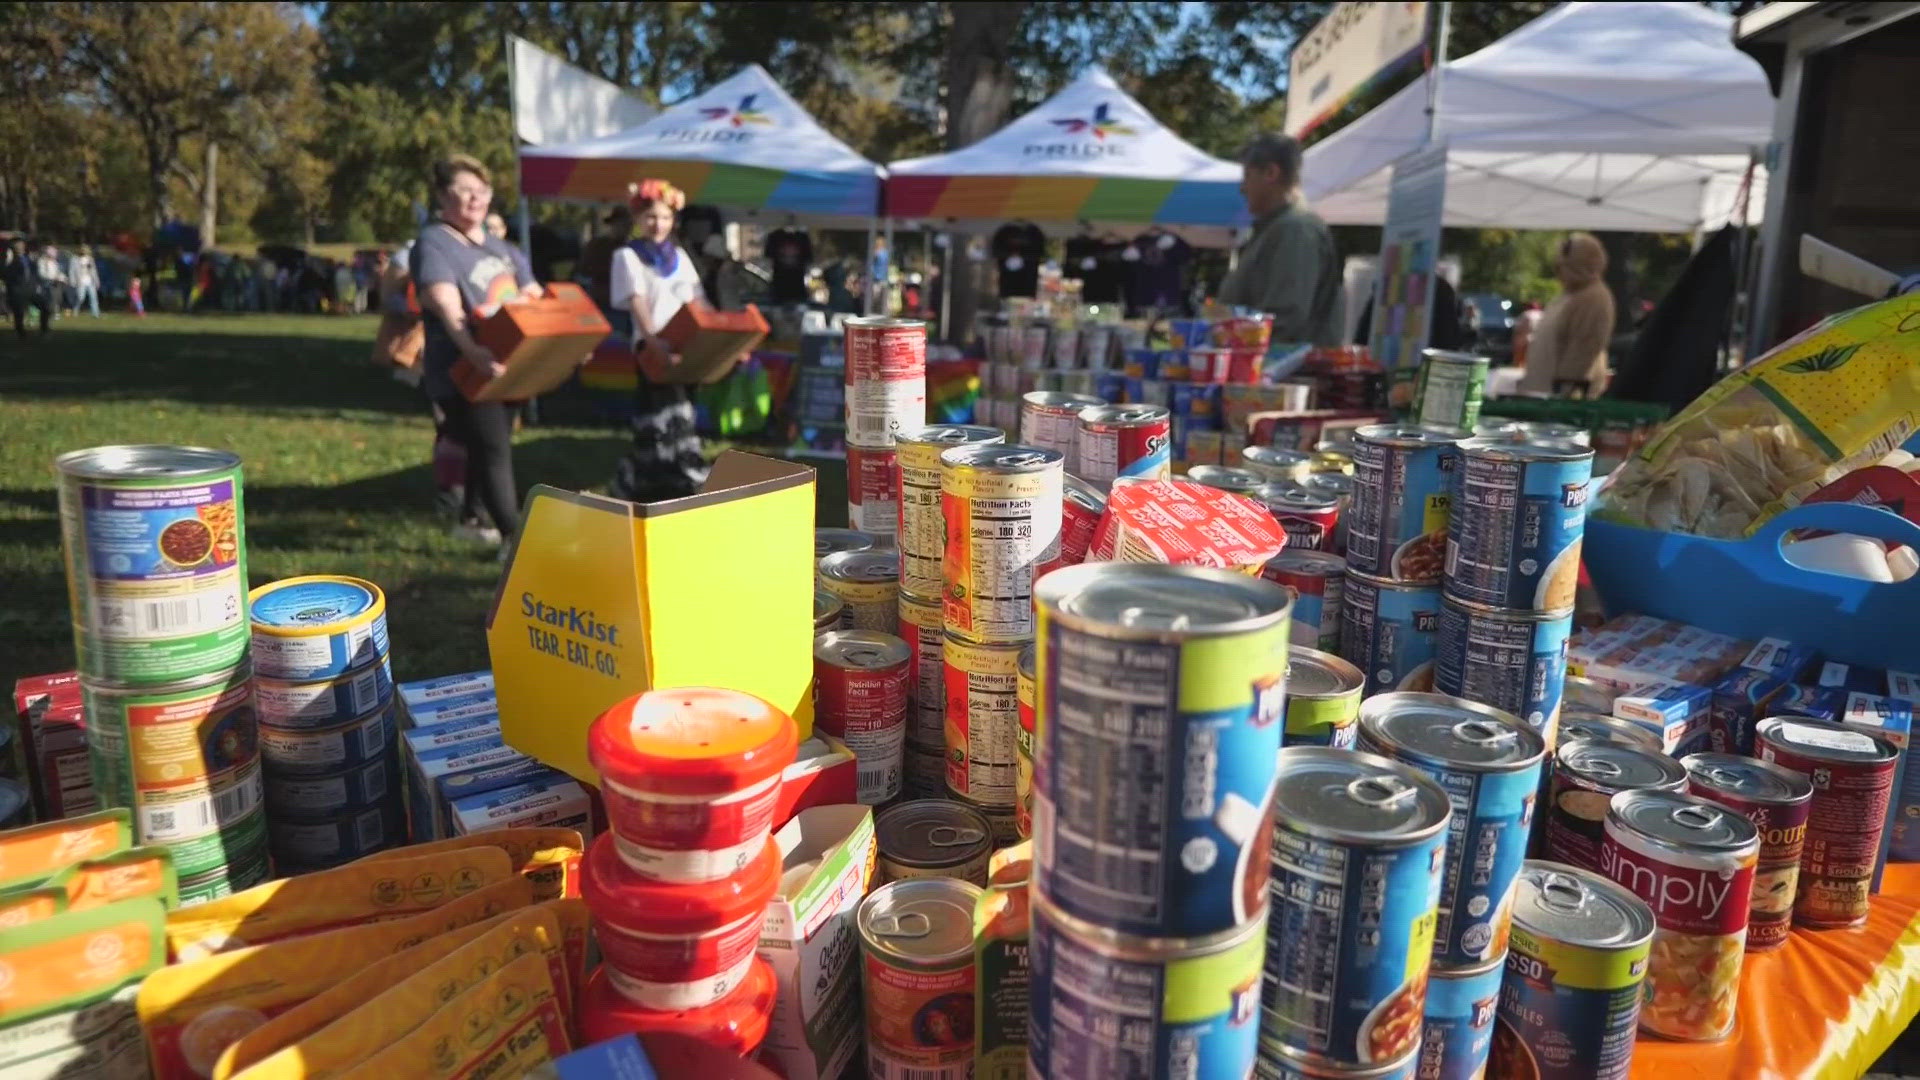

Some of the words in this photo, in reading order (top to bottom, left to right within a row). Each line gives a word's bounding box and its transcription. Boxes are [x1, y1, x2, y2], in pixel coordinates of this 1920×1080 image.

[659, 129, 755, 144] PRIDE
[1022, 142, 1126, 159] PRIDE
[971, 498, 1007, 510] Nutrition
[1009, 499, 1032, 510] Facts
[971, 527, 994, 537] Calories
[998, 526, 1014, 538] 180
[521, 591, 619, 648] StarKist
[527, 625, 564, 659] TEAR.
[566, 638, 594, 670] EAT.
[595, 649, 621, 680] GO.
[848, 681, 881, 690] Nutrition
[968, 673, 1004, 685] Nutrition
[848, 688, 869, 697] Facts
[1600, 843, 1732, 920] simply
